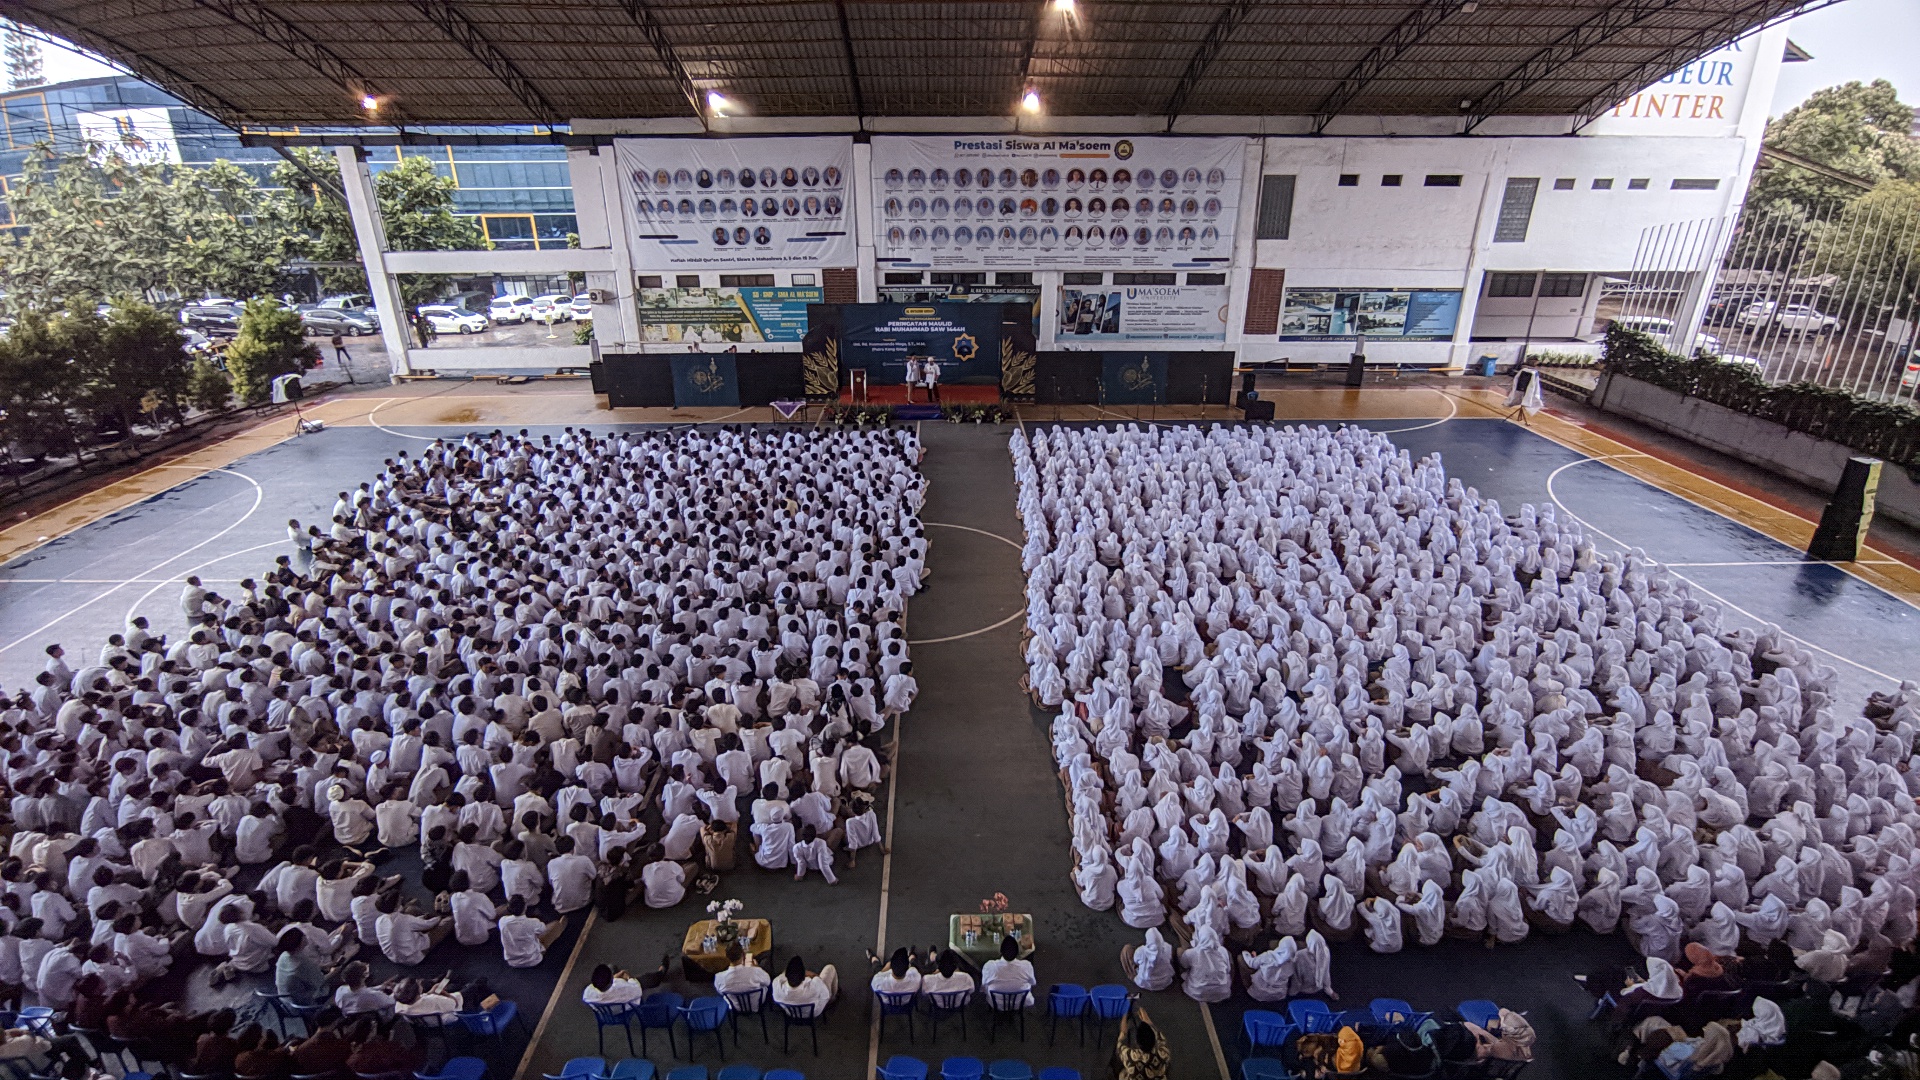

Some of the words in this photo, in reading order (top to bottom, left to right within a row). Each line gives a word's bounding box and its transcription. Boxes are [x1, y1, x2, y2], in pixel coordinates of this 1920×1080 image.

[1611, 93, 1725, 119] PINTER
[954, 140, 1003, 150] Prestasi
[1005, 140, 1040, 150] Siswa
[1058, 139, 1111, 150] Ma'soem
[1137, 288, 1180, 296] MA'SOEM
